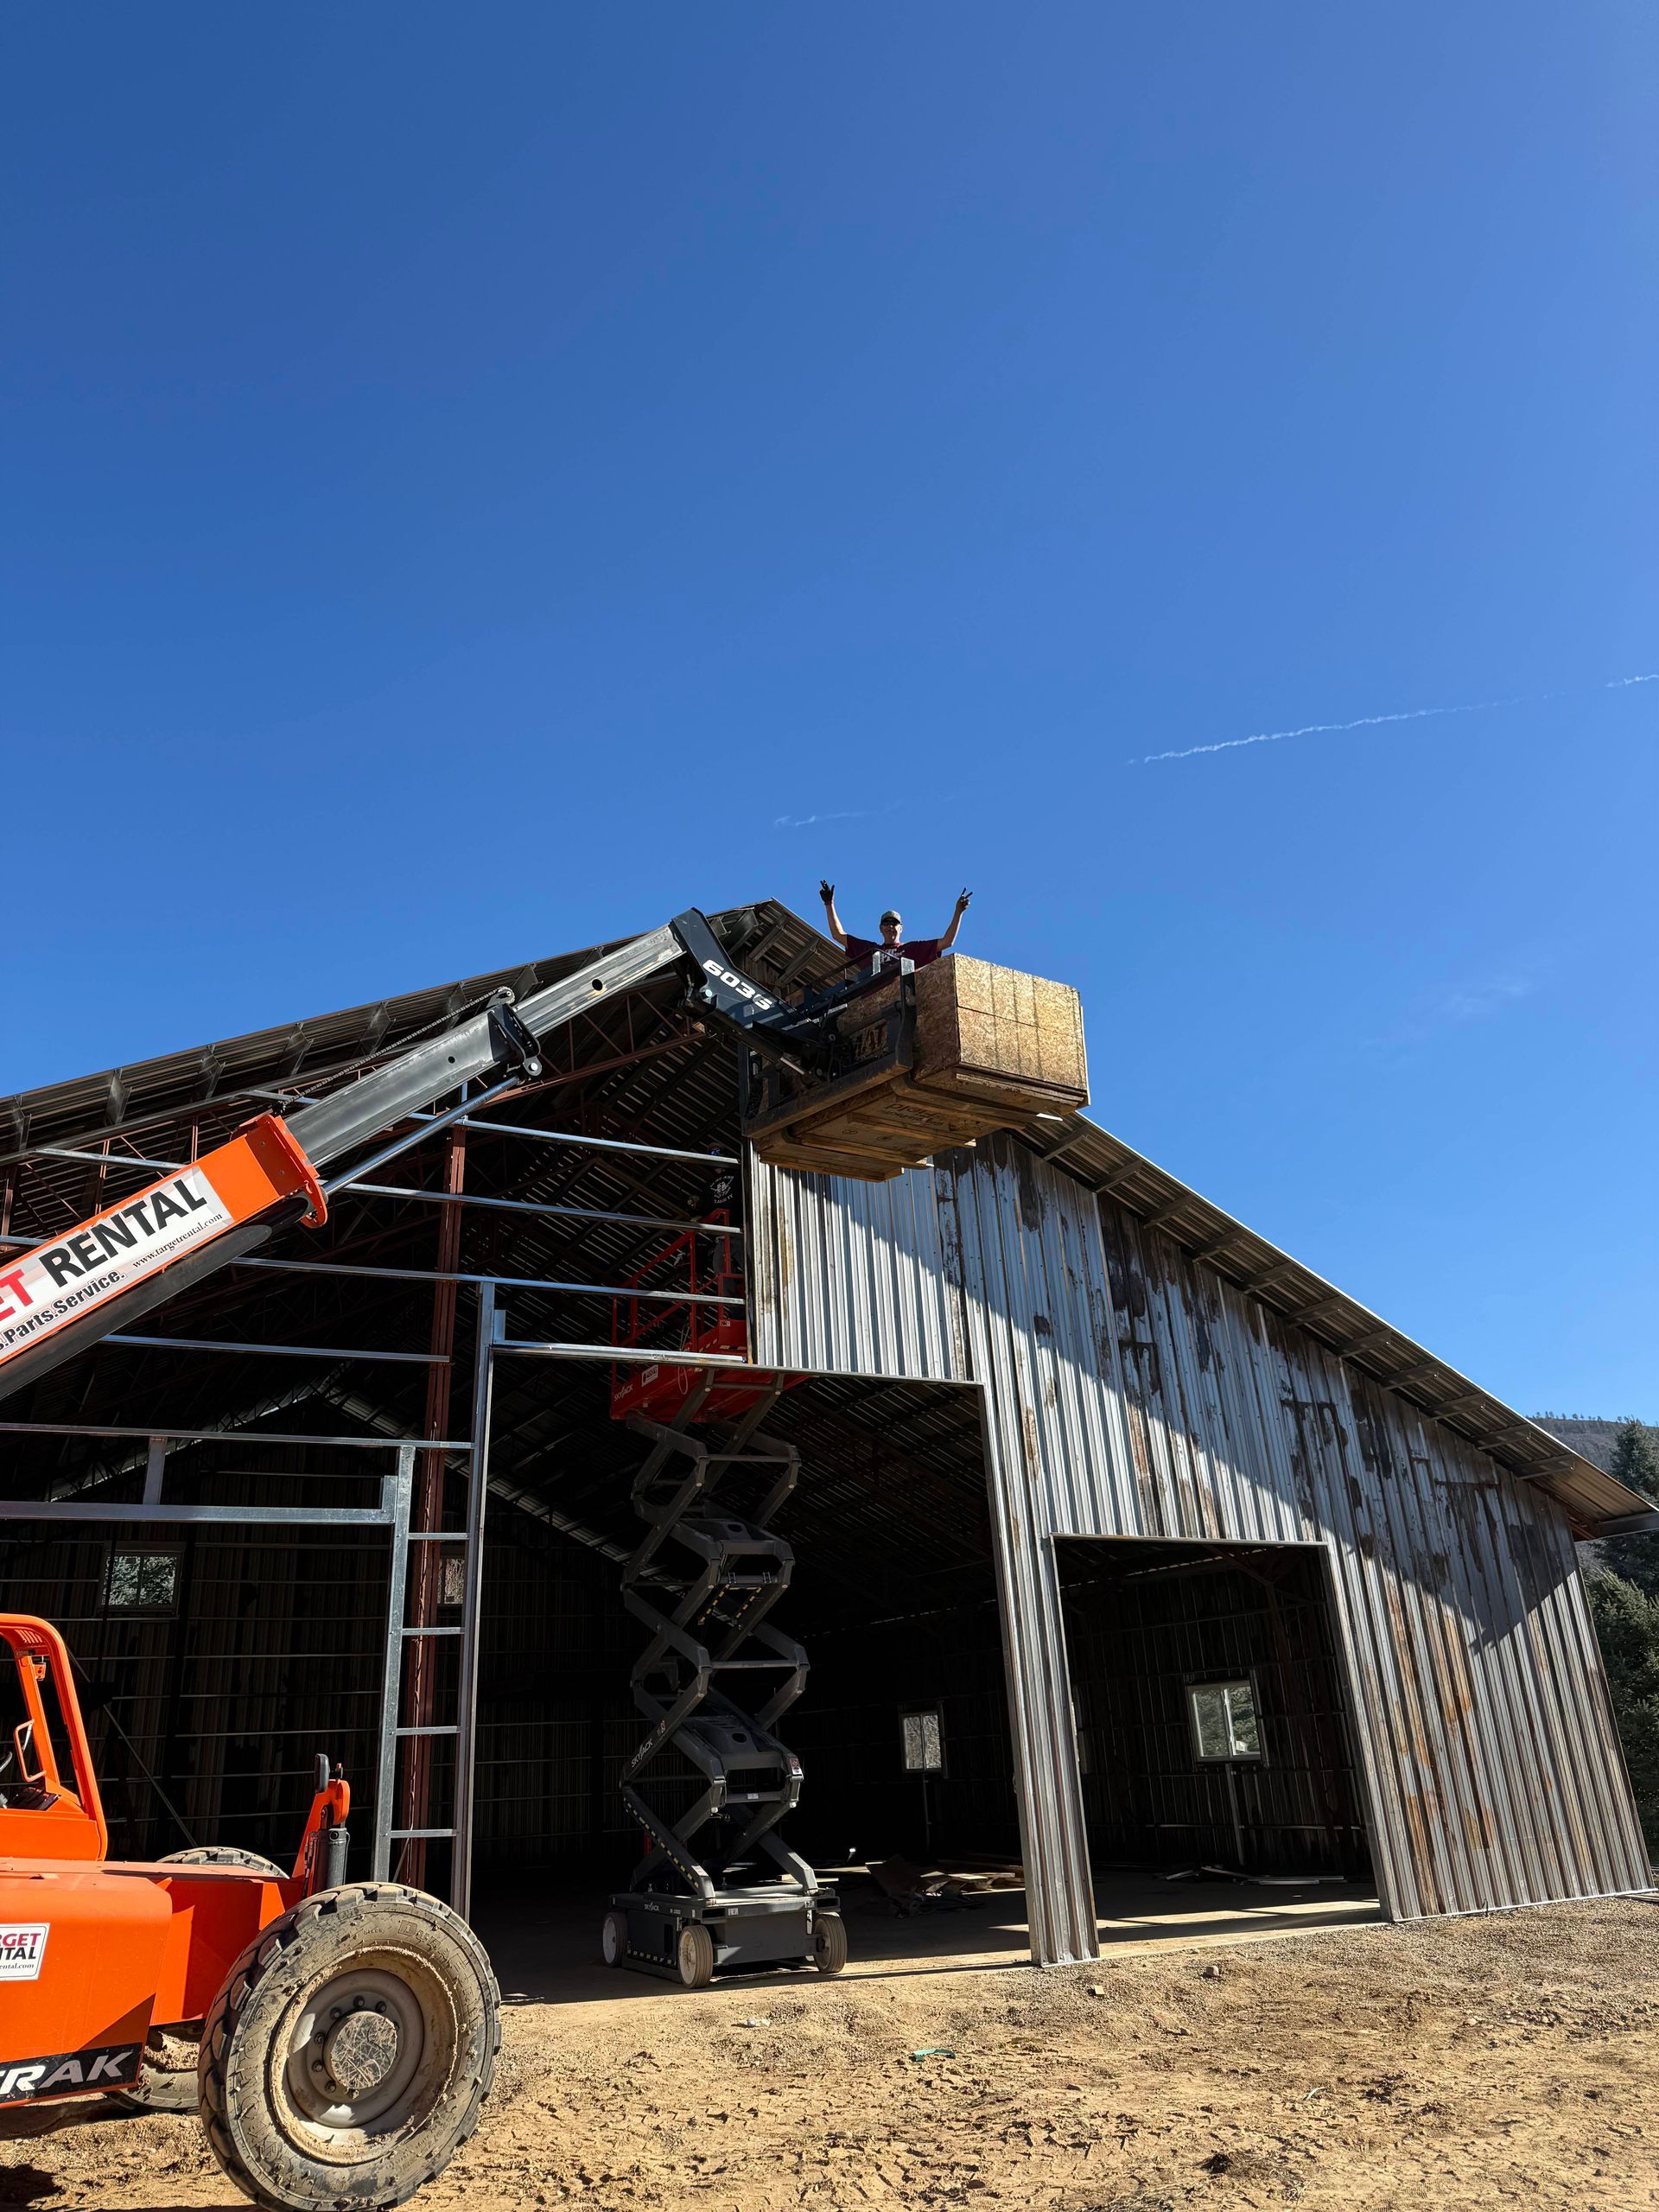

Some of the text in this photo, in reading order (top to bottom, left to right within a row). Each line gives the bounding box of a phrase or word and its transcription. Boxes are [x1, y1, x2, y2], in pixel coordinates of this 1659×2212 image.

[702, 959, 773, 1011] 6036
[39, 1179, 207, 1288] RENTAL
[132, 1213, 223, 1268] www.targetrental.com
[0, 1933, 41, 1947] GET
[0, 2051, 134, 2095] RAK
